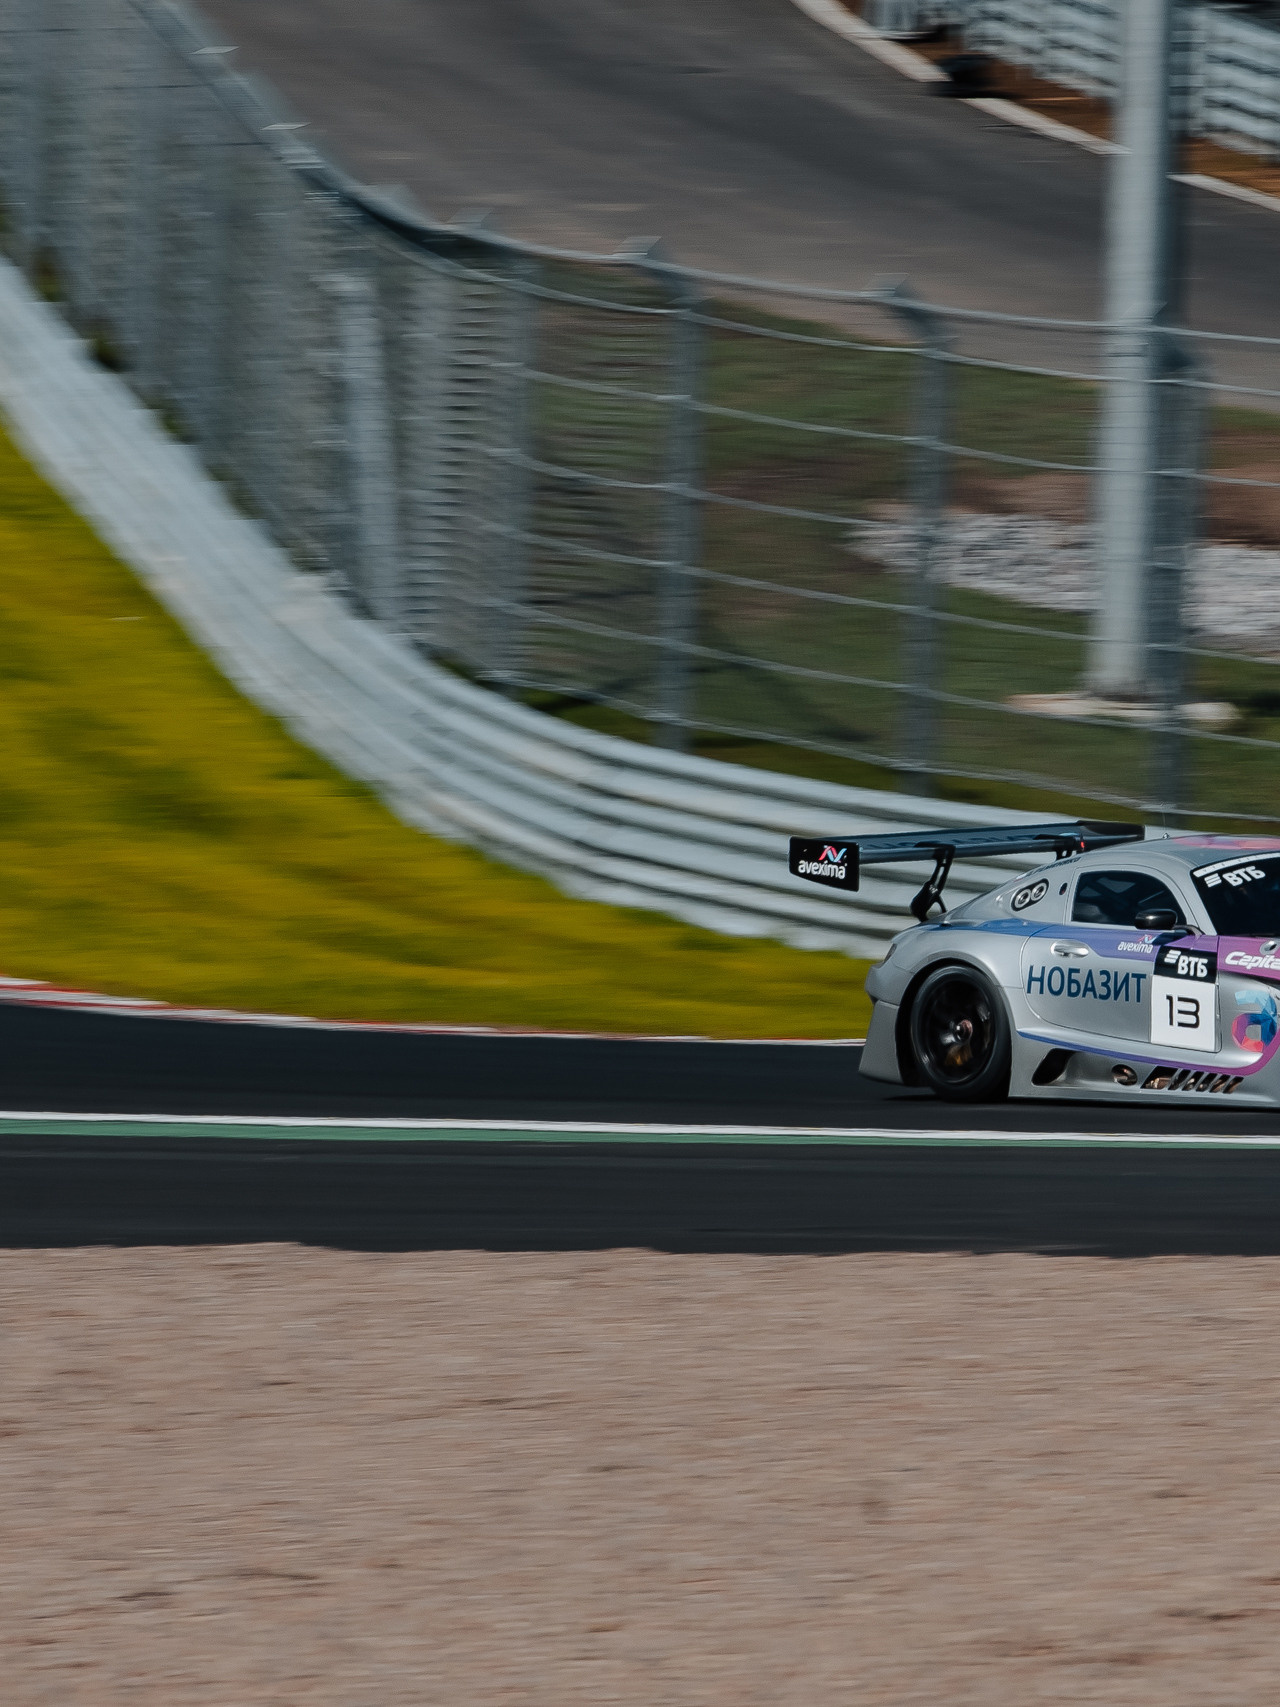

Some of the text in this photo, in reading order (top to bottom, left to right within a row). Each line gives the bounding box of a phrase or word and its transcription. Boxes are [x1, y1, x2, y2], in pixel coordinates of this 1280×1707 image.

[798, 859, 846, 880] avexima
[1222, 865, 1266, 887] ВТБ
[1117, 940, 1154, 954] avexima
[1177, 955, 1209, 978] ВТБ
[1026, 964, 1147, 1003] НОБАЗИТ
[1165, 994, 1200, 1029] 13
